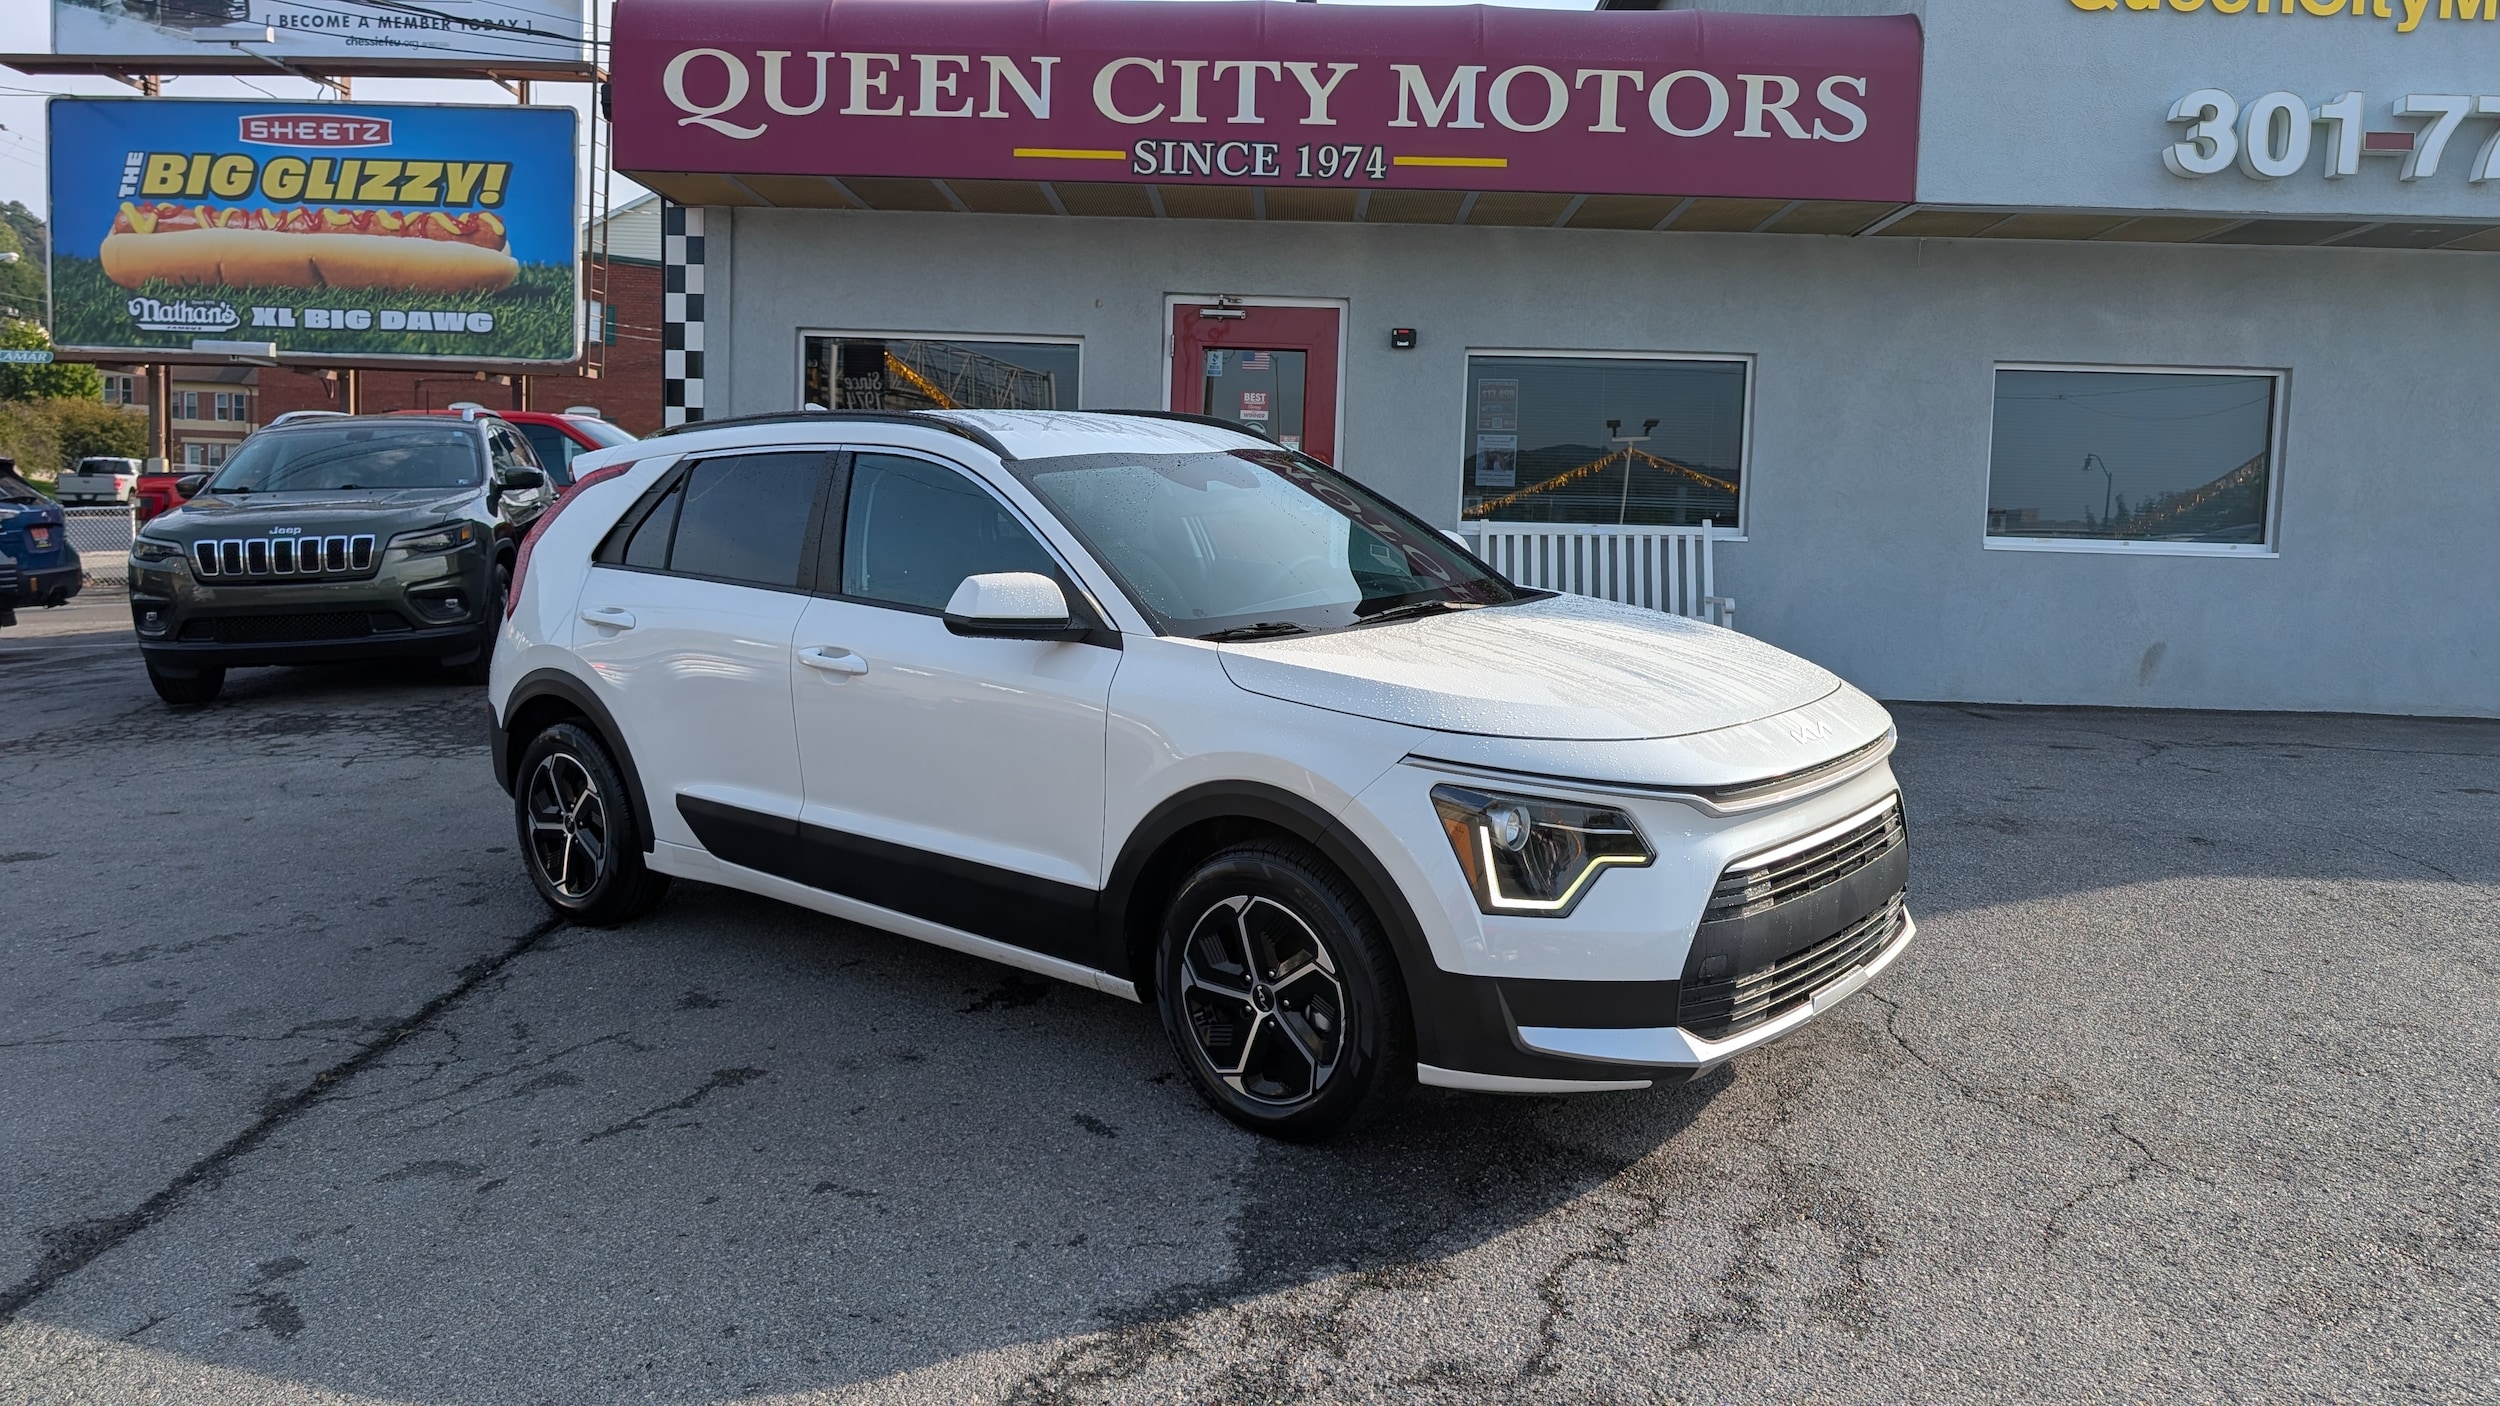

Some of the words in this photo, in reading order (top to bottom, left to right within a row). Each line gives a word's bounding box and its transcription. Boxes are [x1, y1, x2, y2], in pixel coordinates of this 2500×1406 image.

[279, 14, 350, 28] BECOME
[358, 16, 370, 28] A
[378, 17, 450, 31] MEMBER
[662, 47, 1061, 140] QUEEN
[1092, 56, 1358, 126] CITY
[1387, 63, 1869, 143] MOTORS
[249, 120, 382, 142] SHEETZ
[1132, 139, 1281, 178] SINCE
[1296, 144, 1387, 180] 1974
[117, 151, 145, 198] THE
[141, 152, 256, 198] BIG
[261, 157, 508, 205] GLIZZY!
[128, 297, 239, 324] Nathan's
[251, 307, 296, 328] XL
[304, 308, 372, 330] BIG
[380, 309, 494, 333] DAWG
[0, 351, 48, 362] AMAR
[1244, 392, 1266, 402] BEST
[268, 525, 302, 535] Jeep
